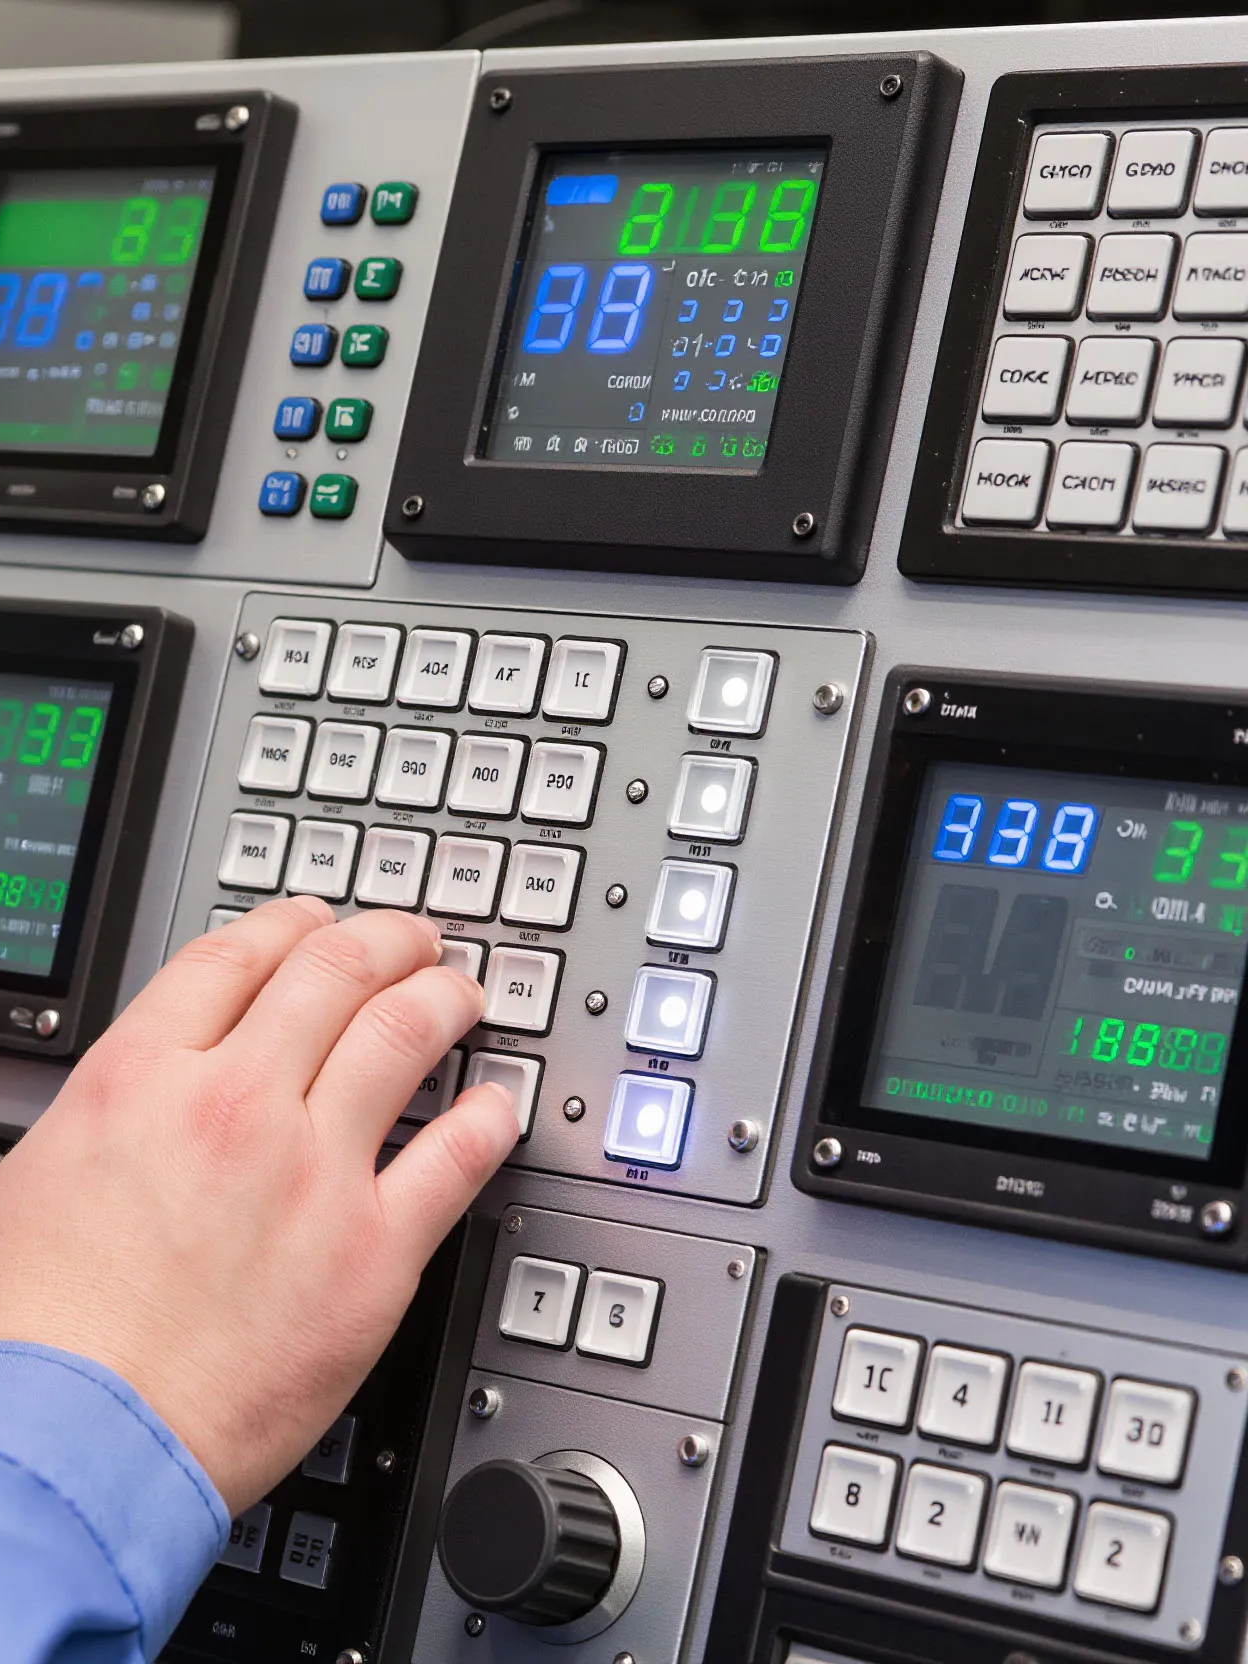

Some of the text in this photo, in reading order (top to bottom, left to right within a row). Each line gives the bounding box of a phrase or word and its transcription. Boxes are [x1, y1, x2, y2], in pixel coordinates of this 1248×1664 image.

[532, 1290, 546, 1312] 7
[952, 1383, 969, 1407] 4
[845, 1482, 862, 1507] 8
[927, 1500, 945, 1527] 2
[1105, 1539, 1124, 1568] 2
